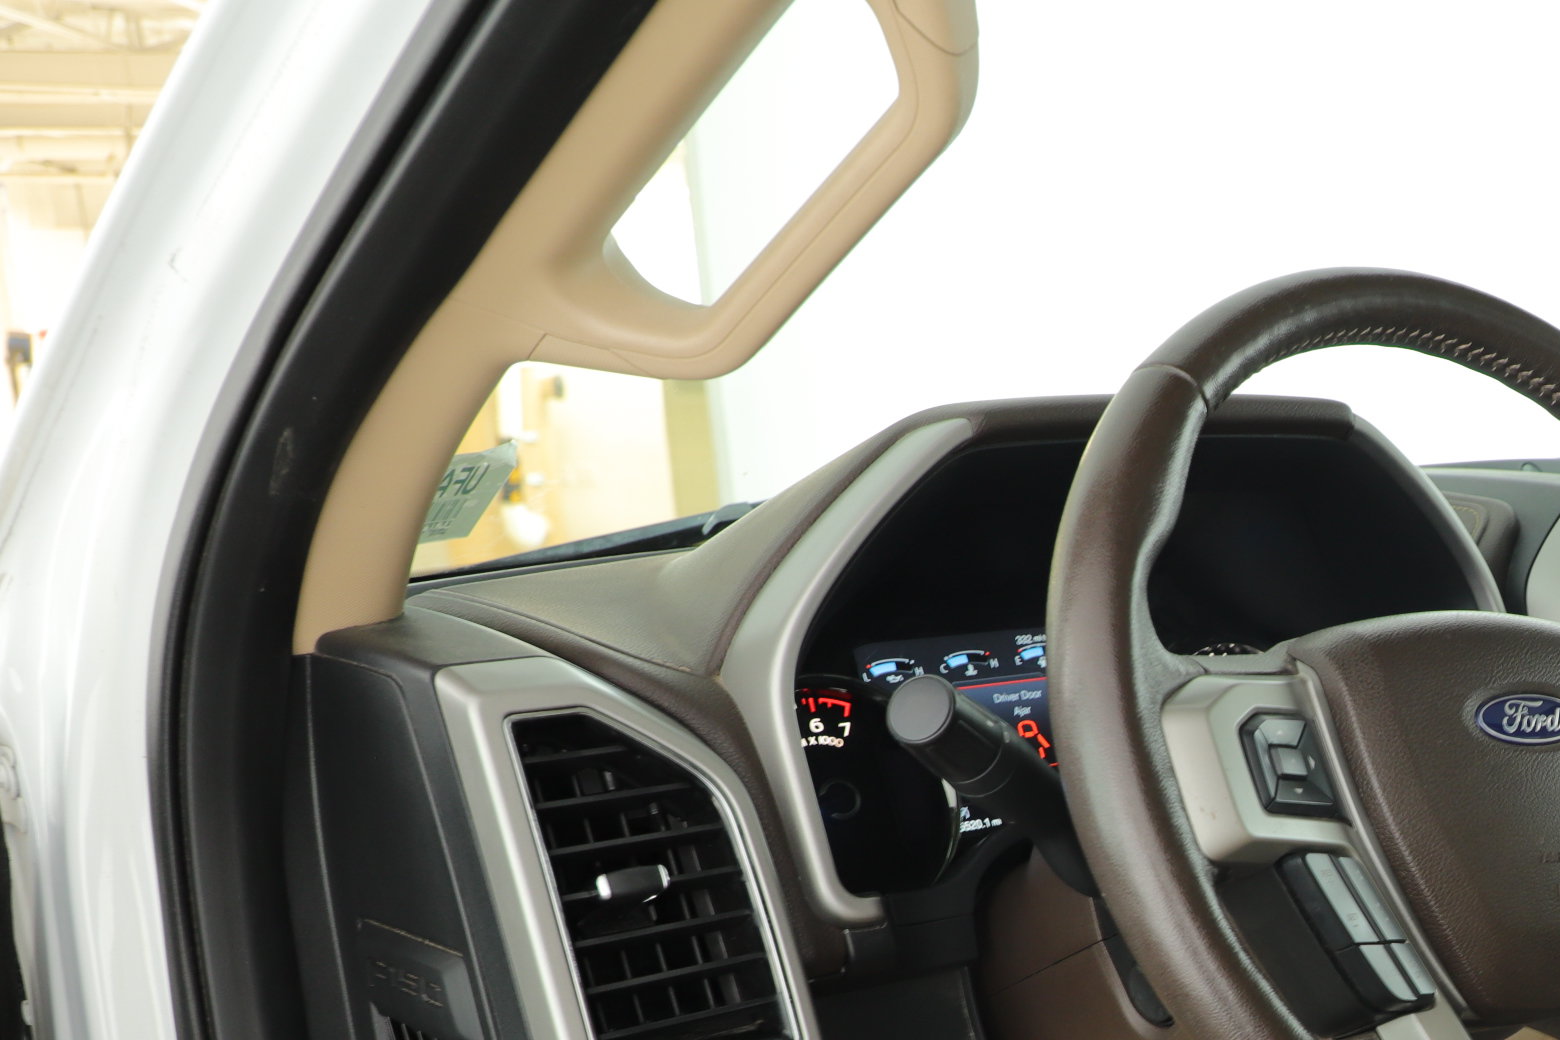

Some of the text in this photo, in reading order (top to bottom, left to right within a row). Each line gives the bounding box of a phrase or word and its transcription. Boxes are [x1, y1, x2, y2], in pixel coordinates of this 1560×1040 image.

[992, 689, 1042, 704] Driver Door
[1013, 705, 1032, 718] Ajar
[809, 717, 852, 738] 6 7
